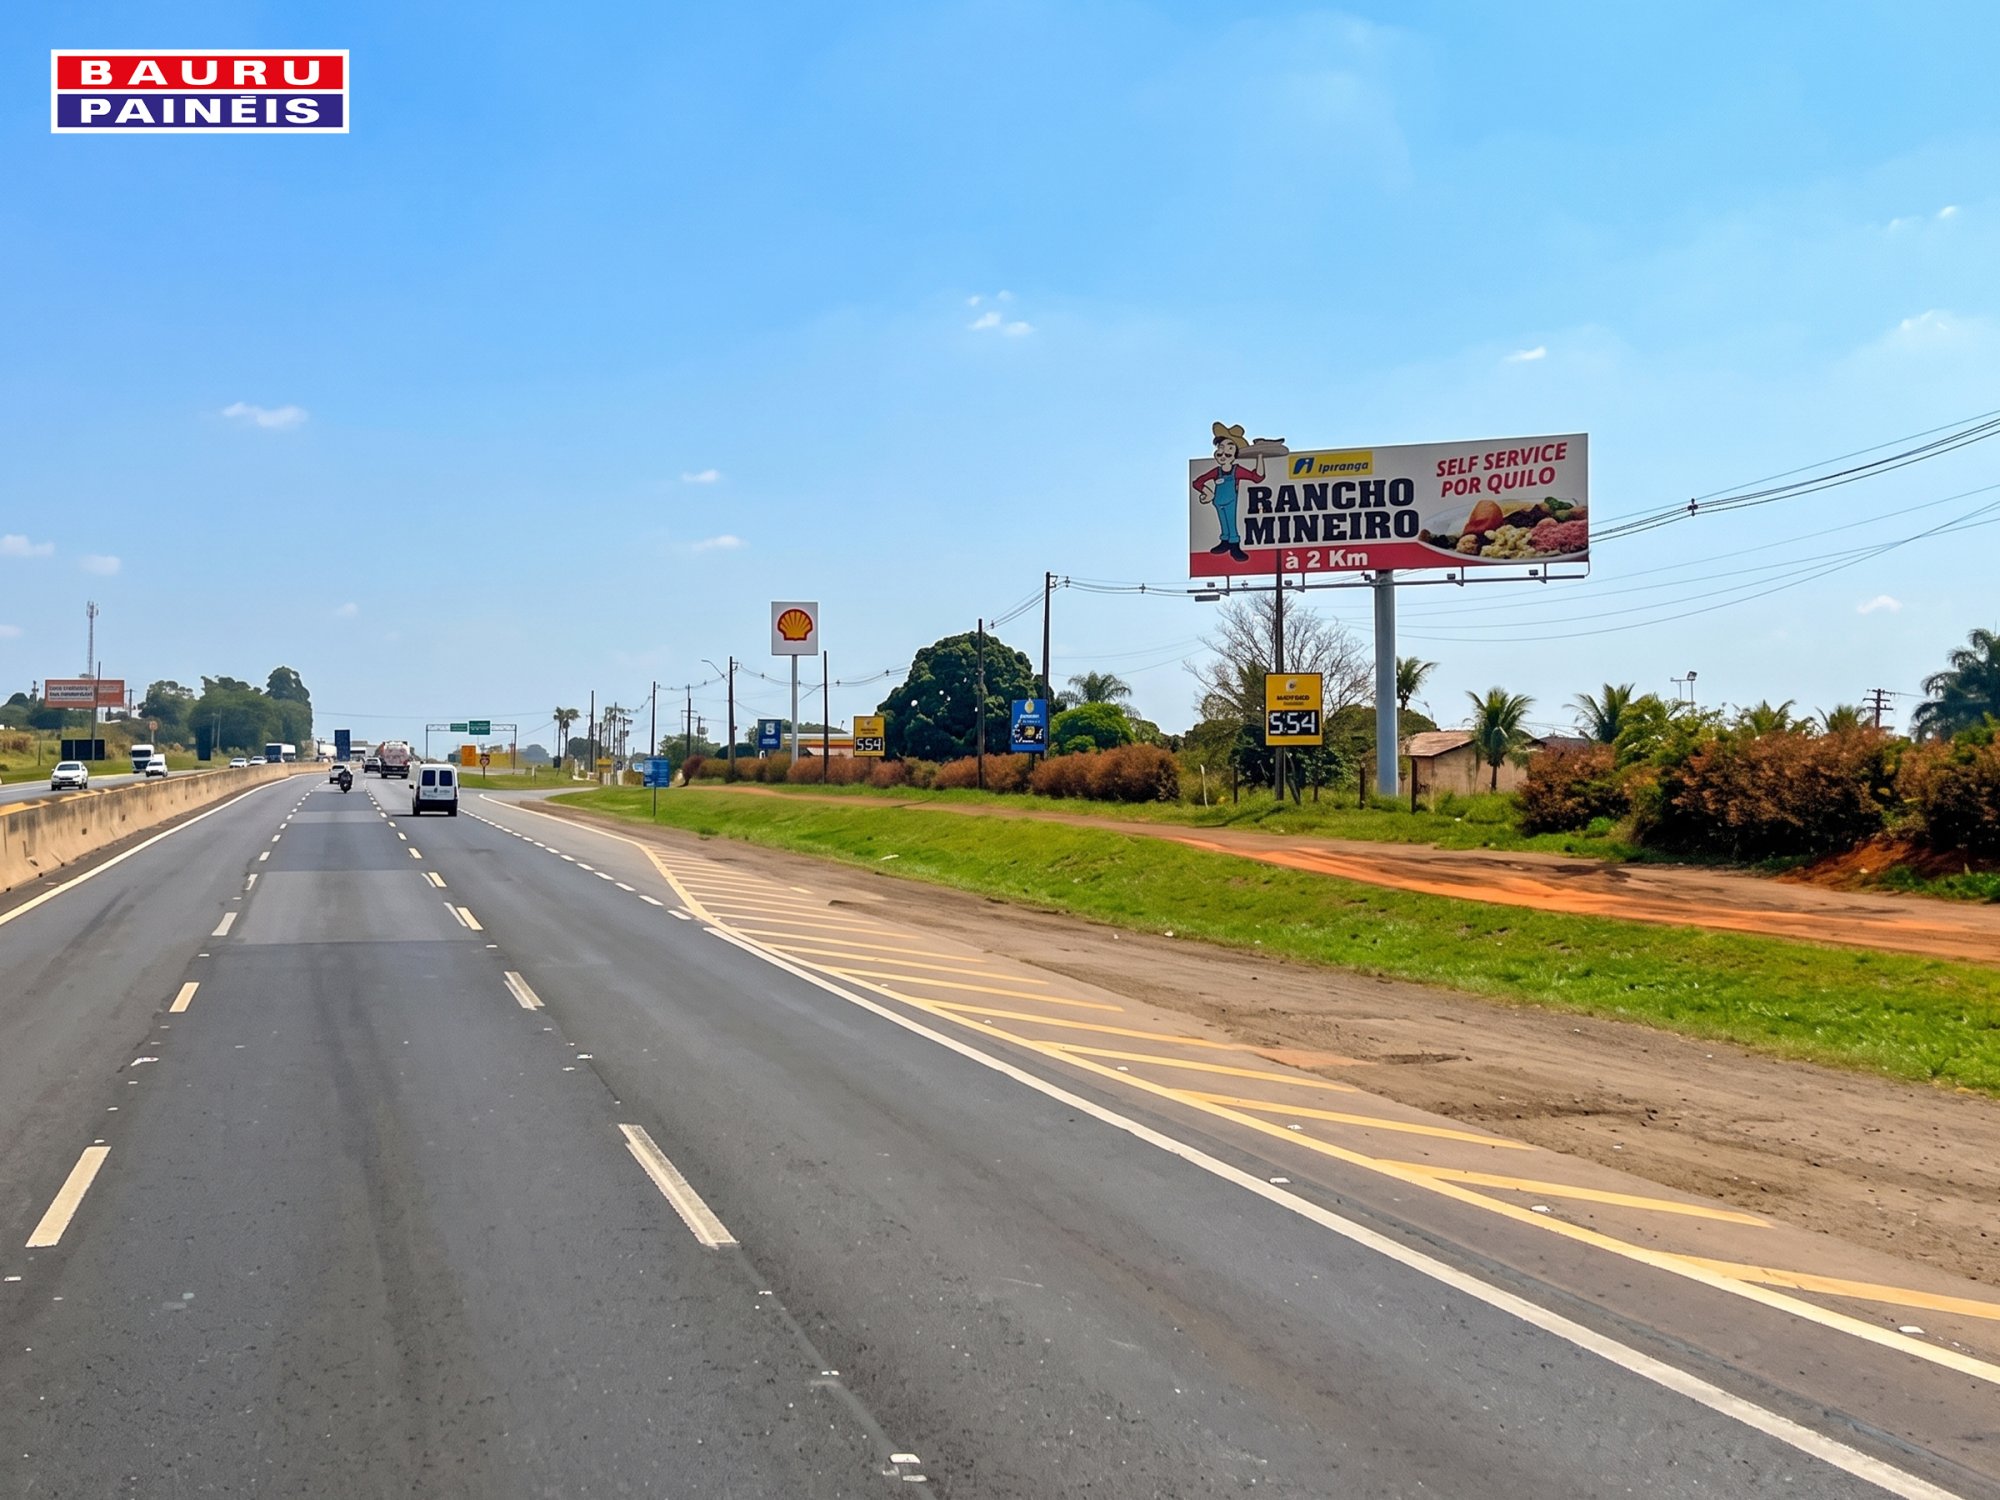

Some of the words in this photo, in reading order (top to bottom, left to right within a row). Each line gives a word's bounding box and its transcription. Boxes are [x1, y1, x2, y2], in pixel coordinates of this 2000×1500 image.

[1436, 454, 1478, 478] SELF
[1482, 442, 1568, 471] SERVICE
[1247, 478, 1415, 514] RANCHO
[1441, 477, 1481, 498] POR
[1487, 466, 1555, 494] QUILO
[1244, 509, 1419, 546] MINEIRO
[1285, 550, 1299, 570] à
[1306, 550, 1321, 567] 2
[1329, 548, 1368, 567] Km
